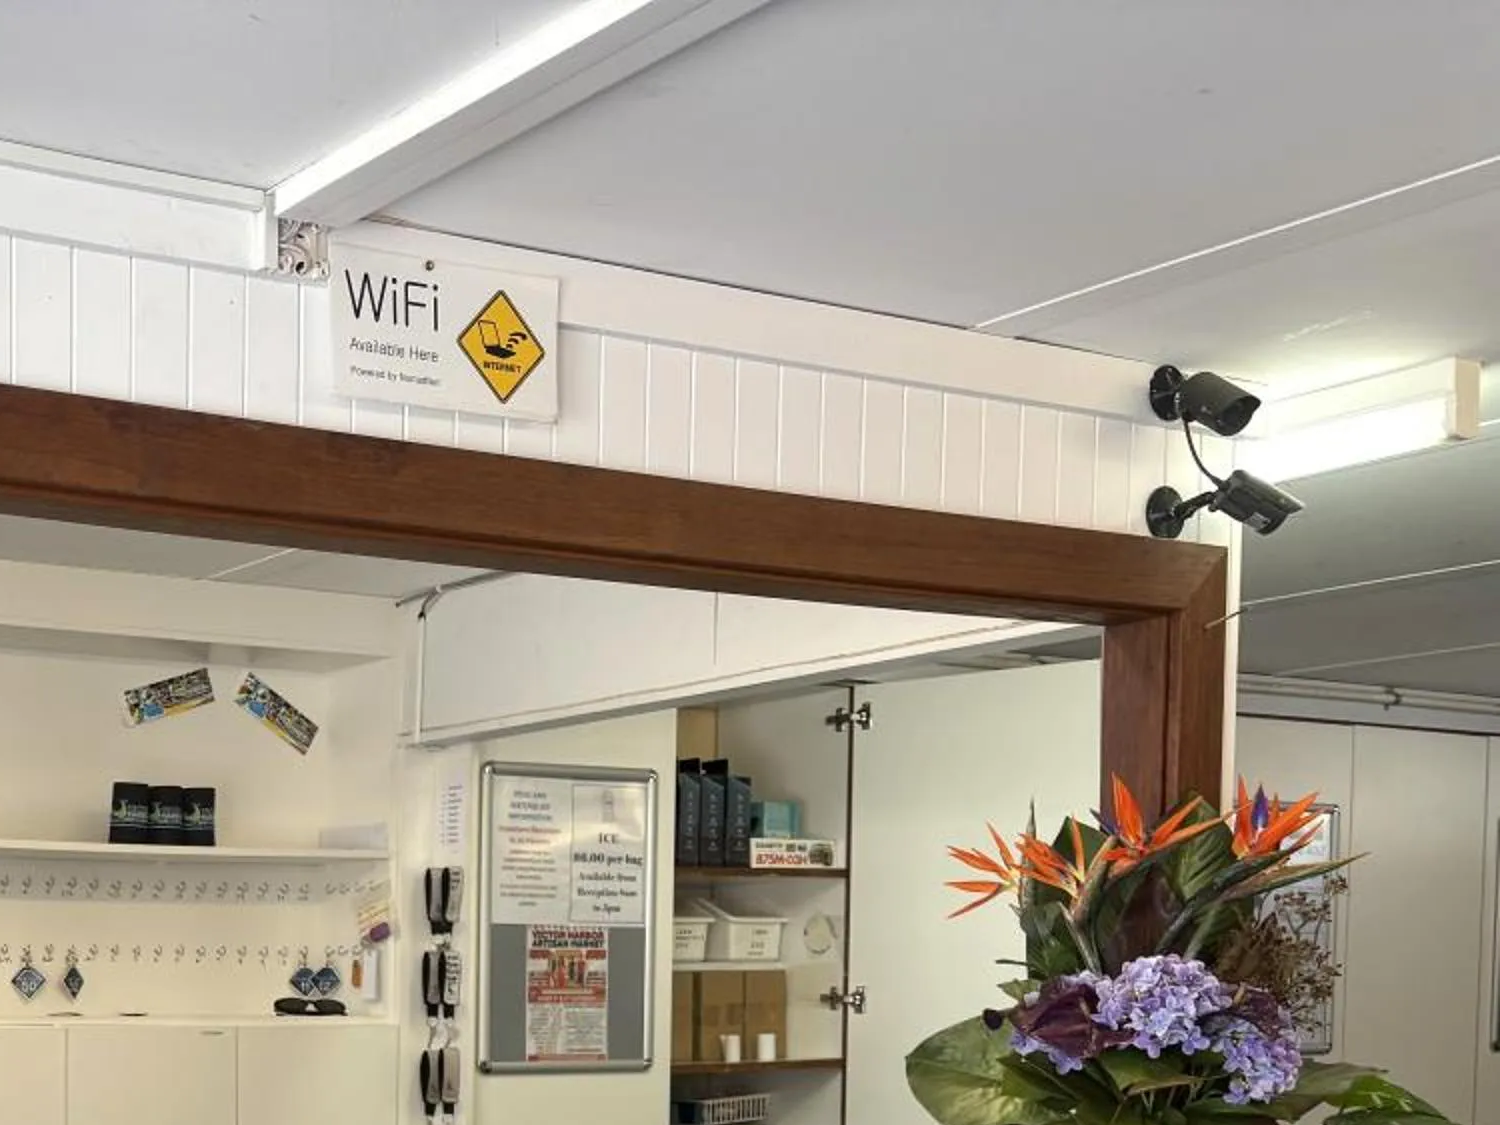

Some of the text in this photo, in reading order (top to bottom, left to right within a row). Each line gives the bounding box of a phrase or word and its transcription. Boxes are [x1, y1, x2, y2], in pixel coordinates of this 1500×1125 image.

[344, 268, 439, 332] WiFi
[349, 337, 439, 363] Available Here
